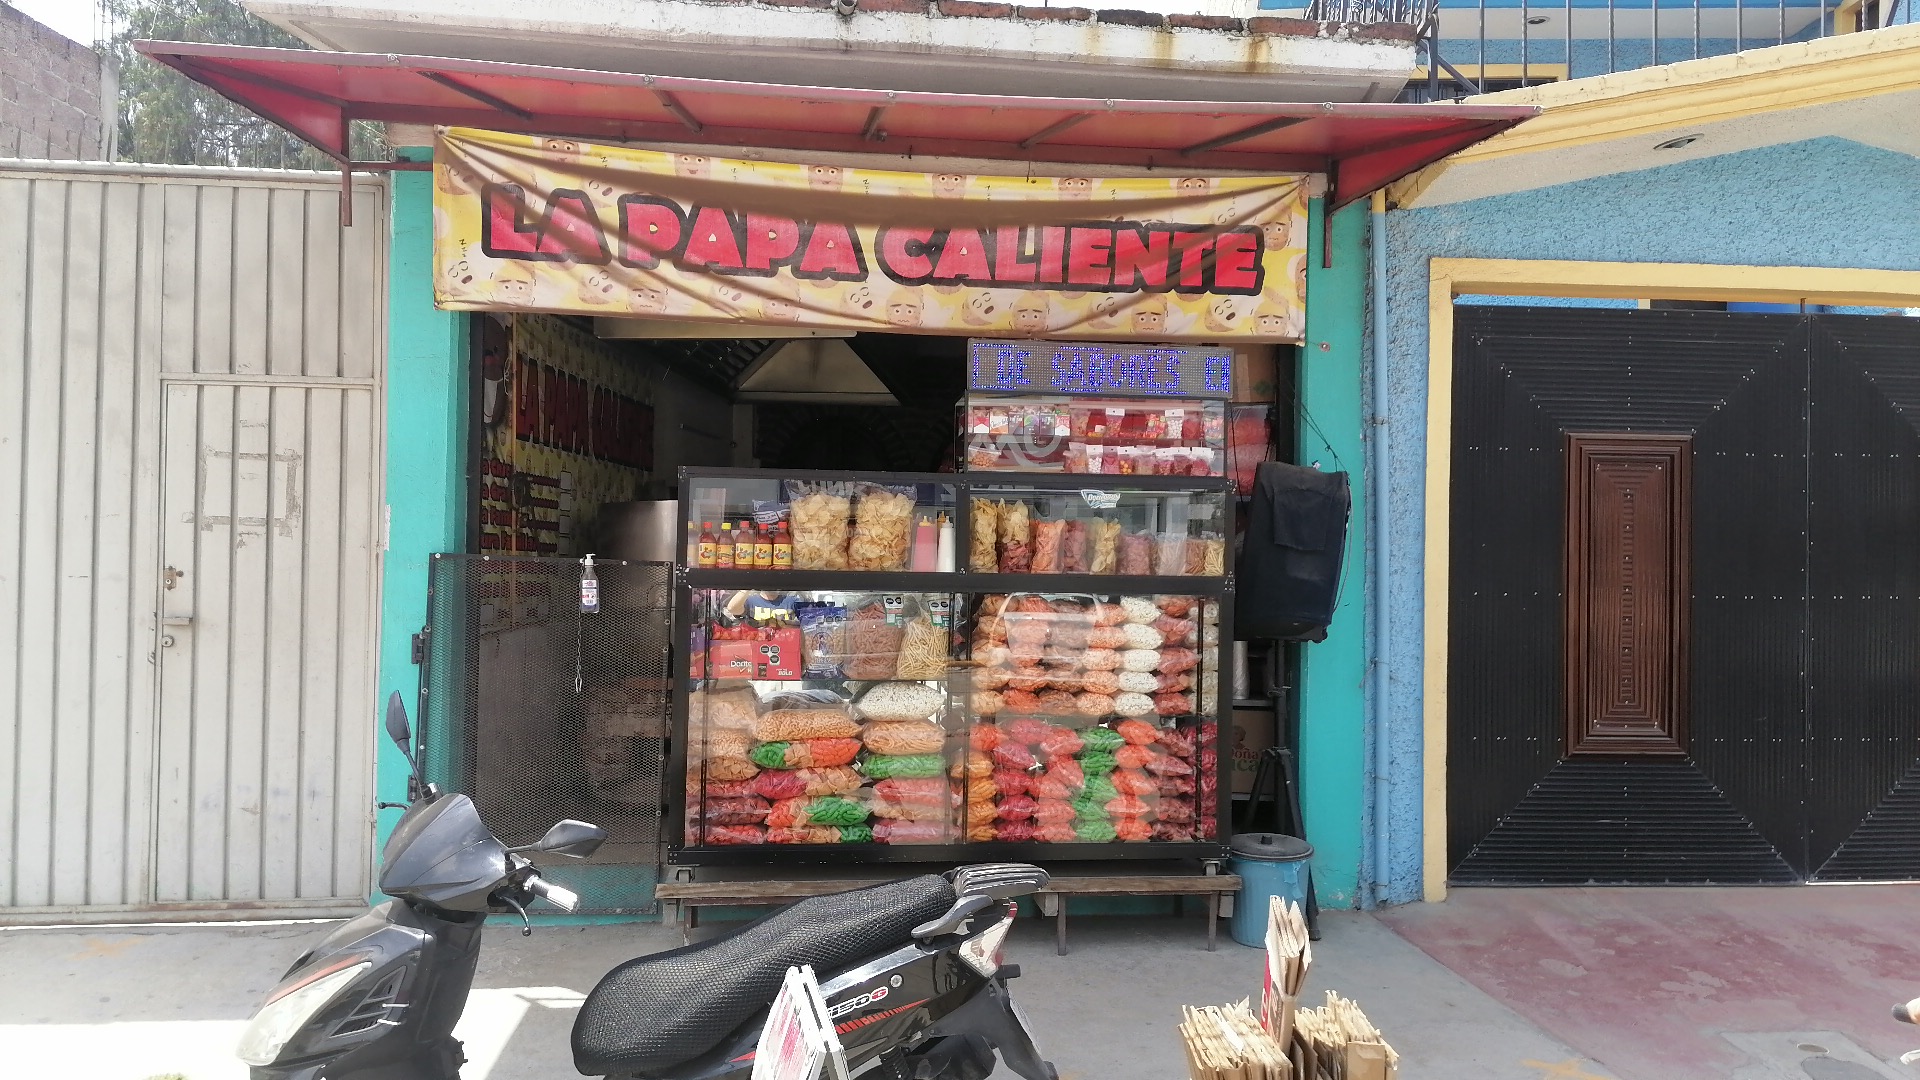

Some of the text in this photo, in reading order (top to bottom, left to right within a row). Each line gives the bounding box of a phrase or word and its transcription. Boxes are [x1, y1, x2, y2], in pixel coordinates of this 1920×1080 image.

[482, 182, 1265, 295] LA PAPA CALIENTE
[544, 364, 589, 457] PAPA
[998, 350, 1031, 385] DE
[1051, 352, 1180, 389] SABORES
